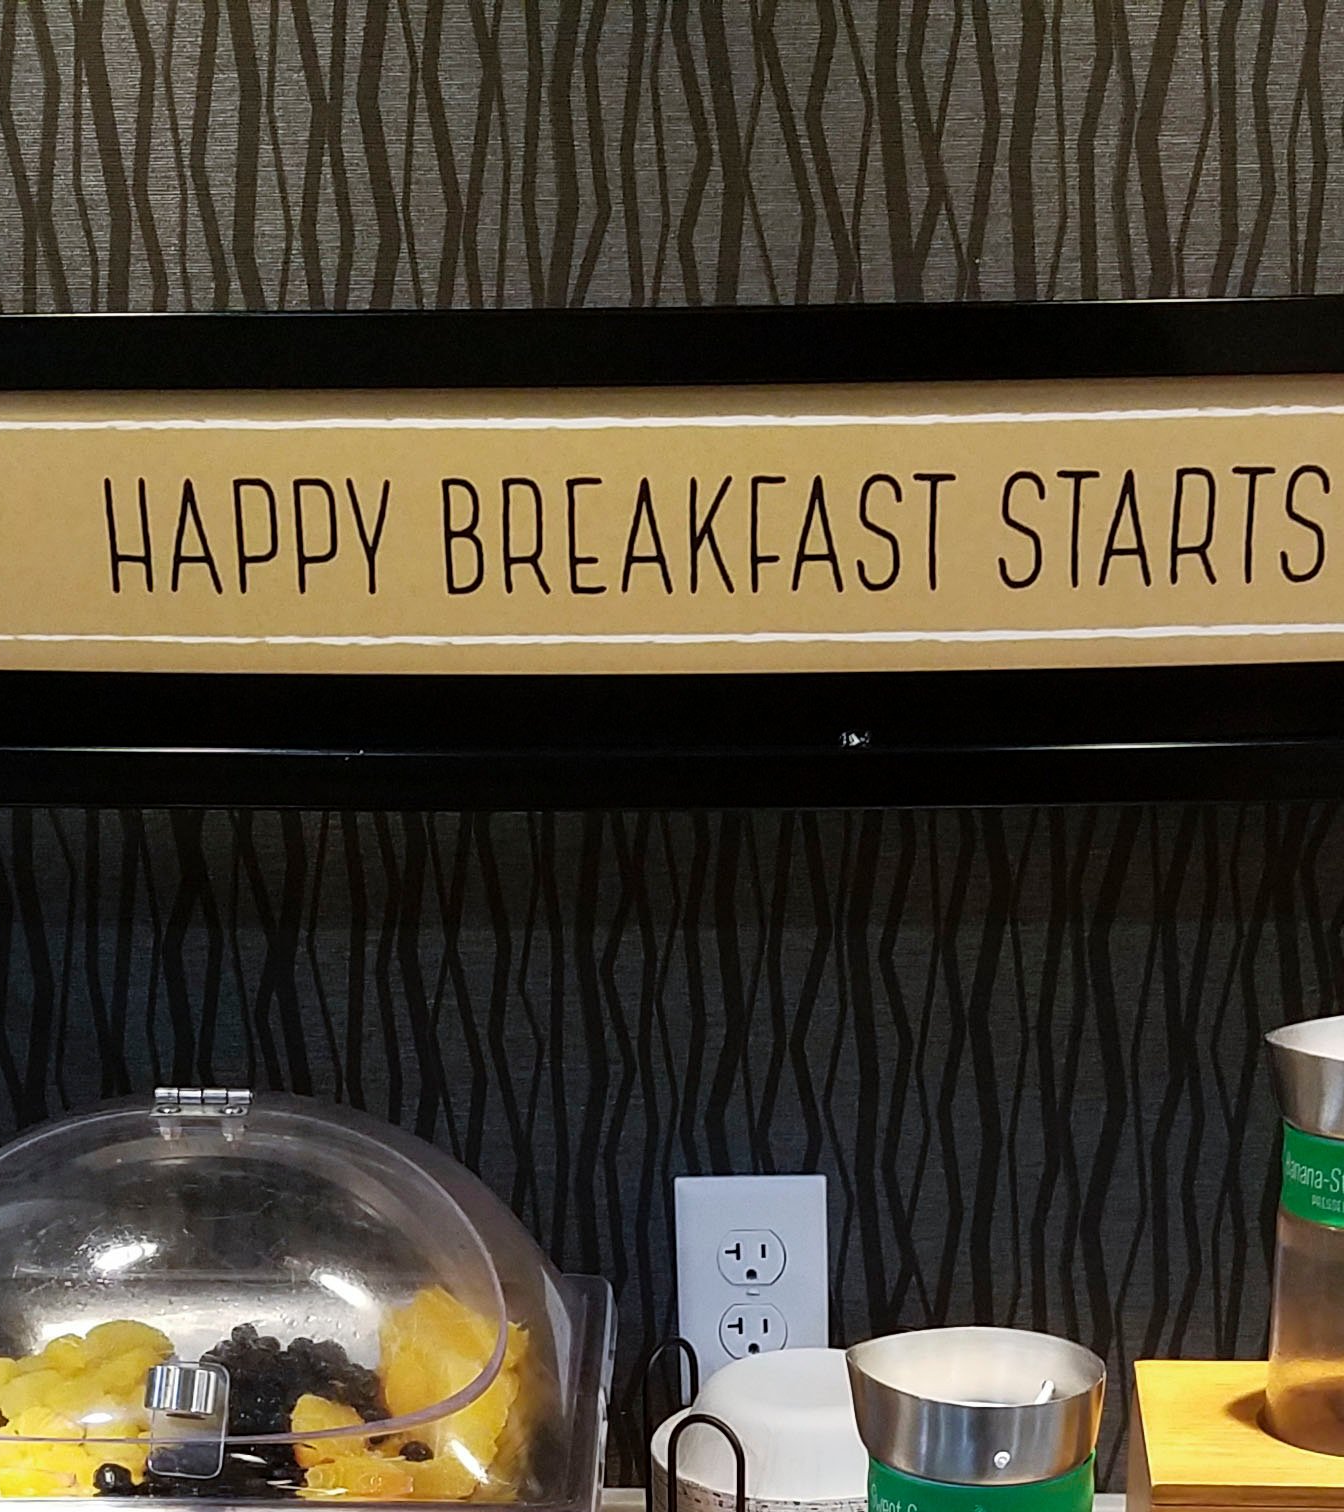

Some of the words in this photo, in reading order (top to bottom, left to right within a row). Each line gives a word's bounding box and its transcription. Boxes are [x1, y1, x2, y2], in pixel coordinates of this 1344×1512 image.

[104, 477, 390, 595] HAPPY
[441, 473, 956, 595] BREAKFAST
[998, 464, 1331, 589] STARTS
